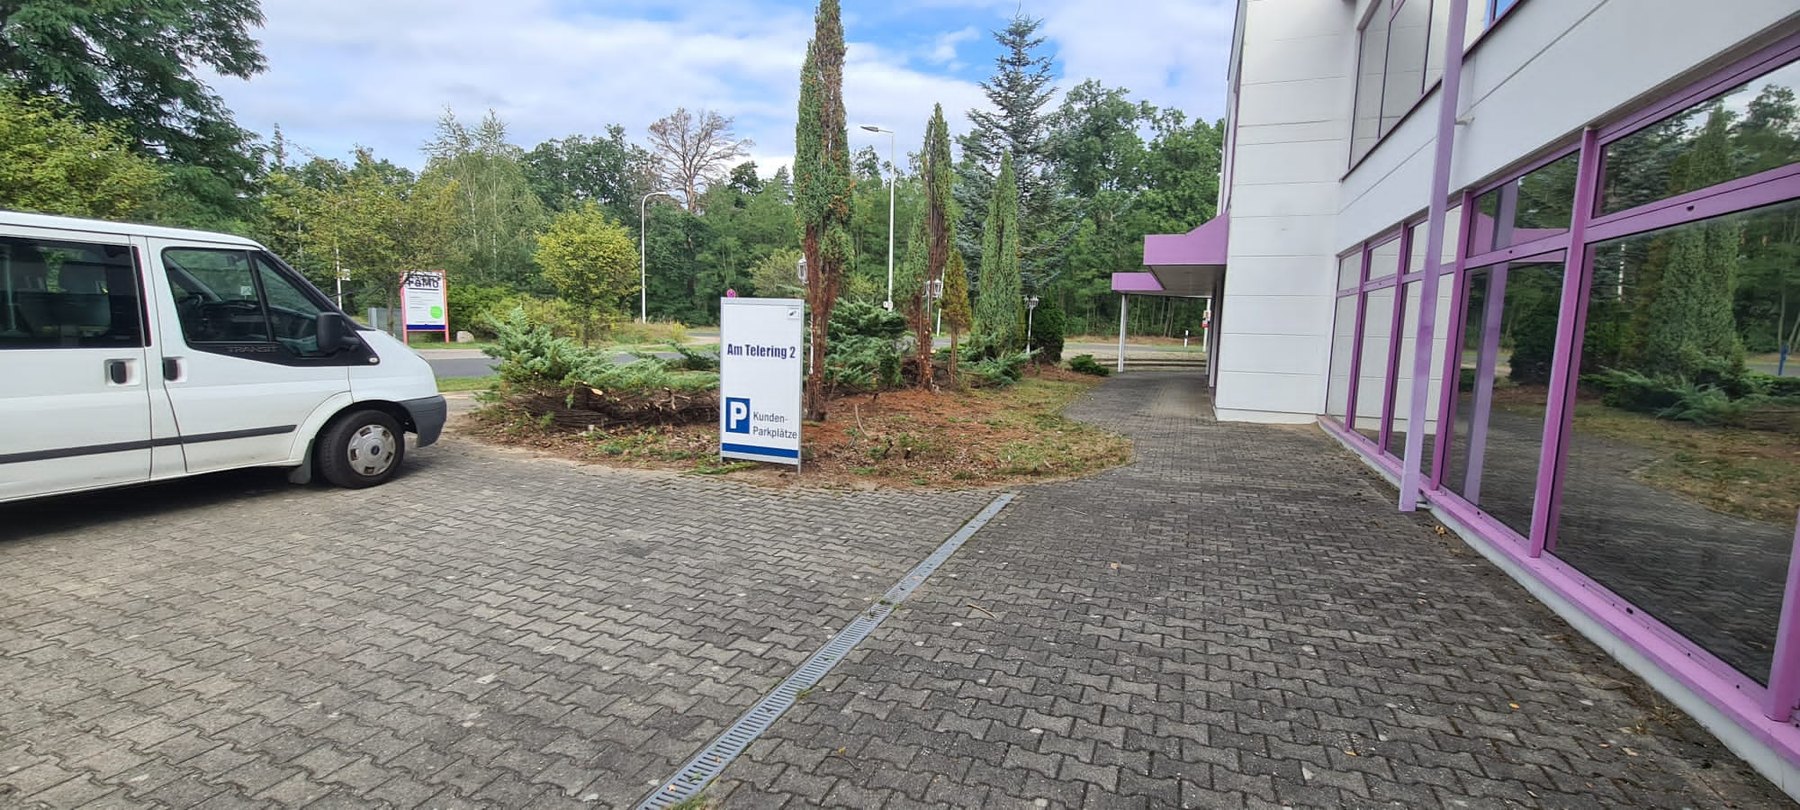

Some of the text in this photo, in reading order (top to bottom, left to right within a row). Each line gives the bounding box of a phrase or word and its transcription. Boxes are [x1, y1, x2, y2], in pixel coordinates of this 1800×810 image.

[727, 343, 796, 359] Am Telering 2
[730, 401, 748, 430] P
[753, 412, 788, 424] Kunden-
[753, 426, 798, 440] Parkplätze
